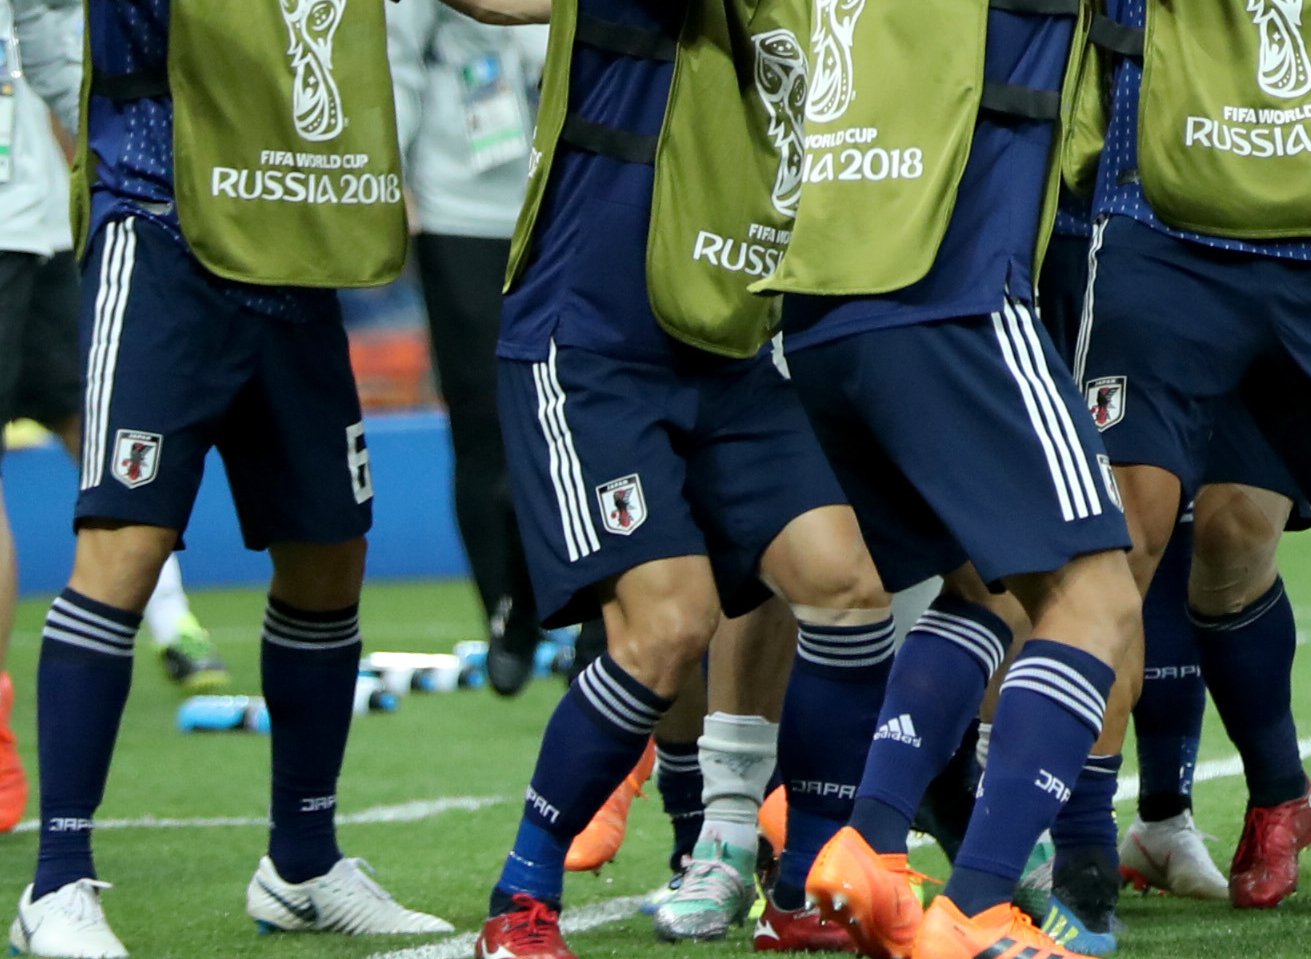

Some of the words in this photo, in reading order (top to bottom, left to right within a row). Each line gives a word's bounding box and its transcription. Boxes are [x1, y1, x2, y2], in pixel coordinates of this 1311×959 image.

[1230, 105, 1257, 123] FIFA
[845, 128, 878, 143] CUP
[261, 150, 295, 166] FIFA
[296, 153, 341, 169] WORLD
[342, 154, 368, 169] CUP
[838, 147, 924, 181] 2018
[212, 167, 338, 204] RUSSIA
[340, 173, 401, 204] 2018
[748, 223, 776, 243] FIFA
[1144, 665, 1202, 680] JAP
[873, 731, 922, 749] adidas
